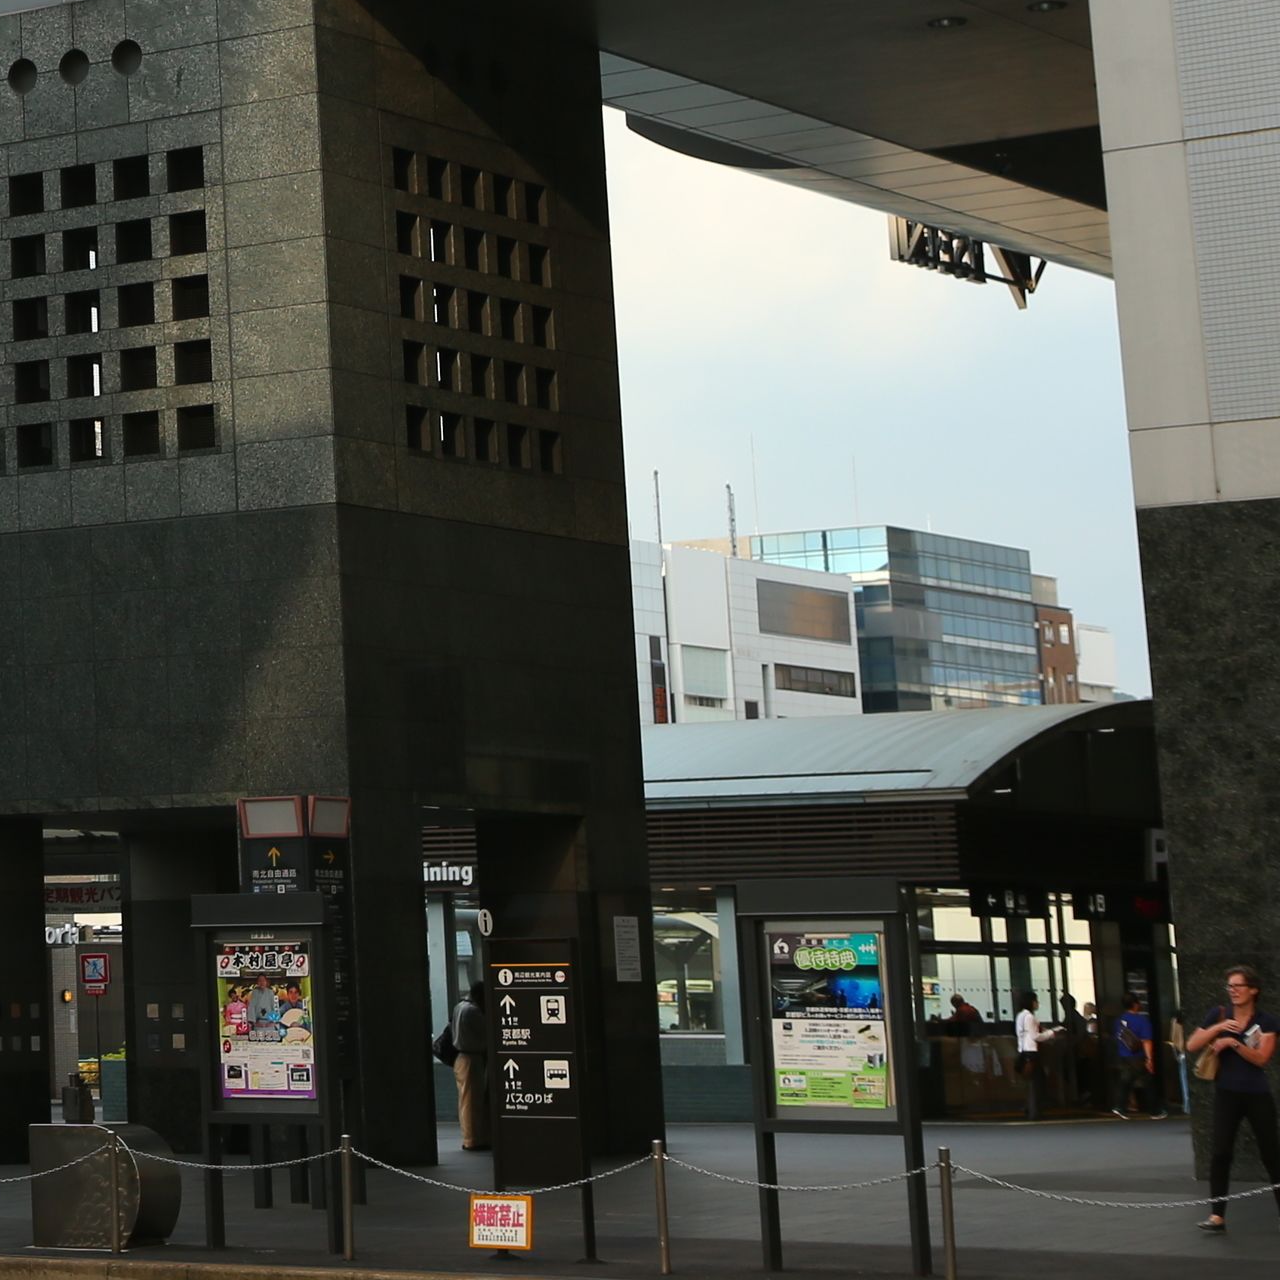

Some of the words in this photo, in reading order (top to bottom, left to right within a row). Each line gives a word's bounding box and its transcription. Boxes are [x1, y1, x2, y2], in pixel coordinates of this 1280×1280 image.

[796, 950, 855, 967] 優待特典
[502, 1028, 530, 1039] 京都駅
[505, 1092, 553, 1104] バスのりば
[474, 1202, 524, 1227] 横断禁止
